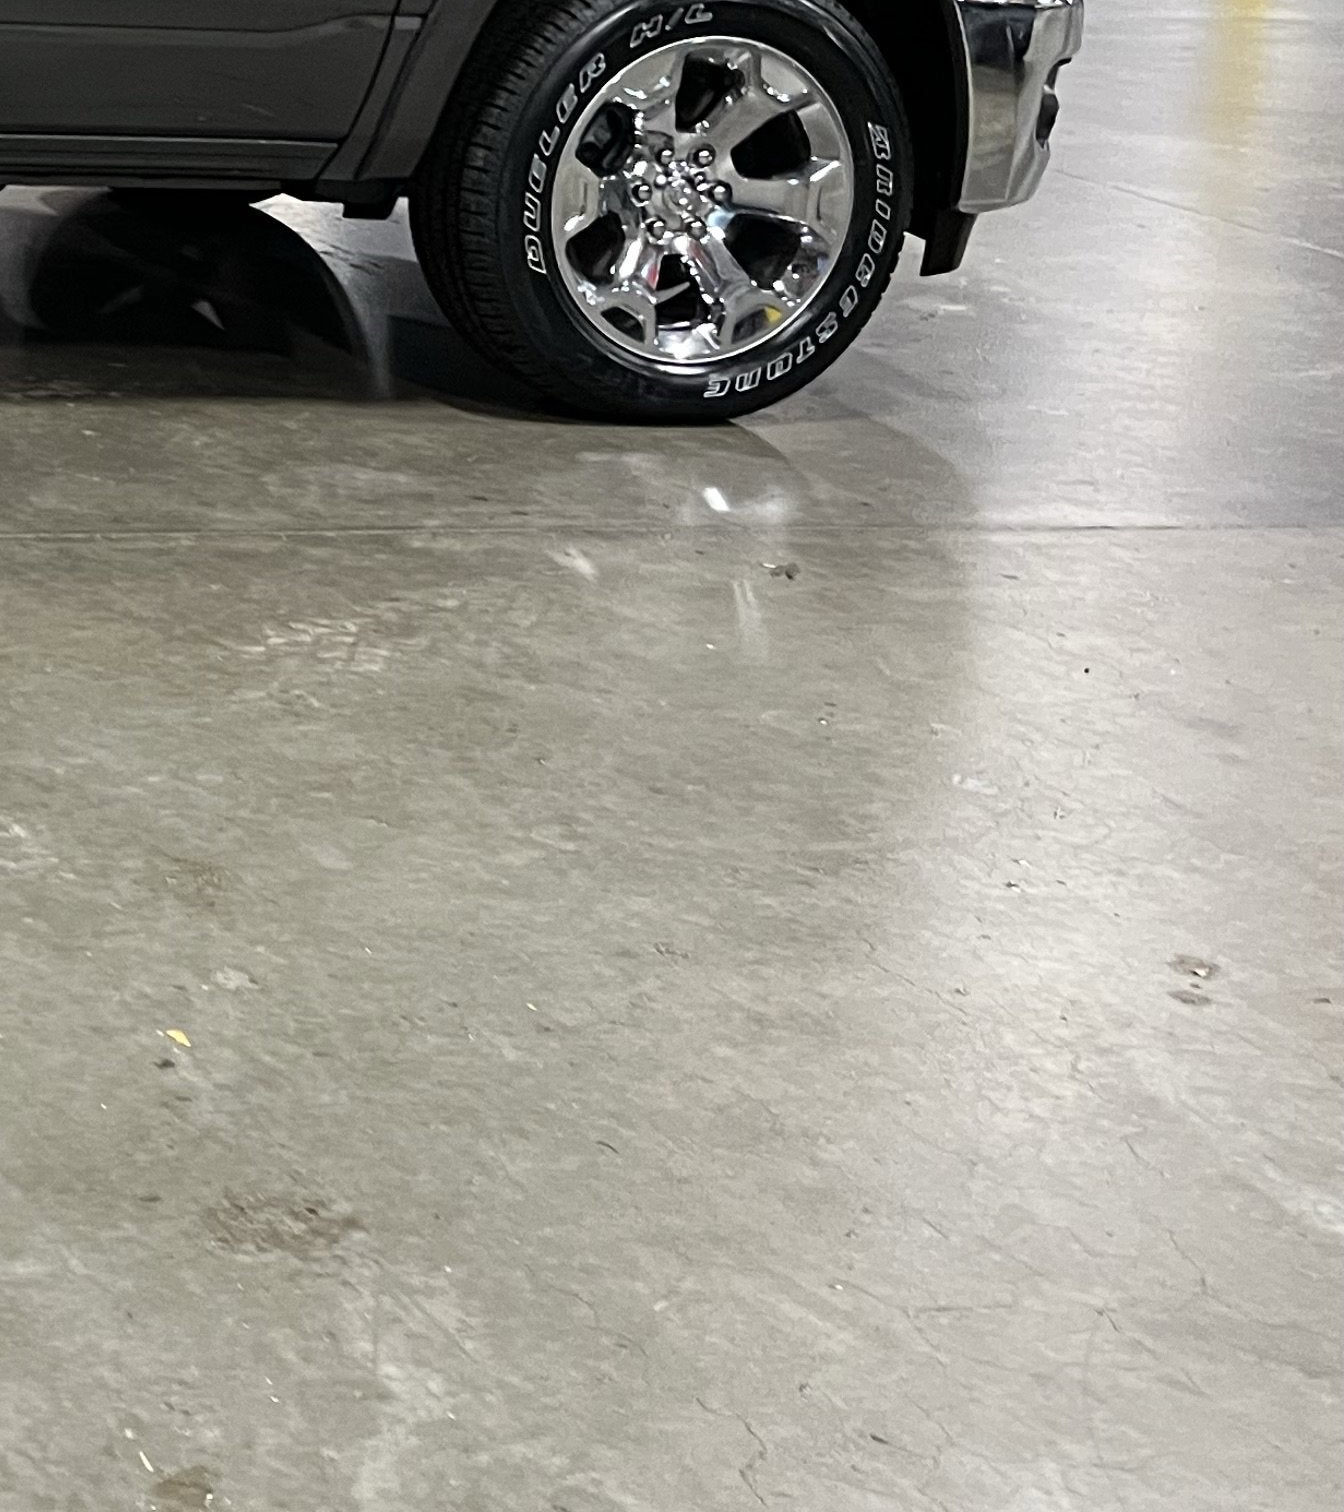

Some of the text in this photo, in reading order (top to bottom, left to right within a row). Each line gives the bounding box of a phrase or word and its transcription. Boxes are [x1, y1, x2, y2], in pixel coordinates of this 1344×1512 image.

[523, 3, 713, 275] DUELER H/L
[703, 121, 894, 398] BRIDGESTONE
